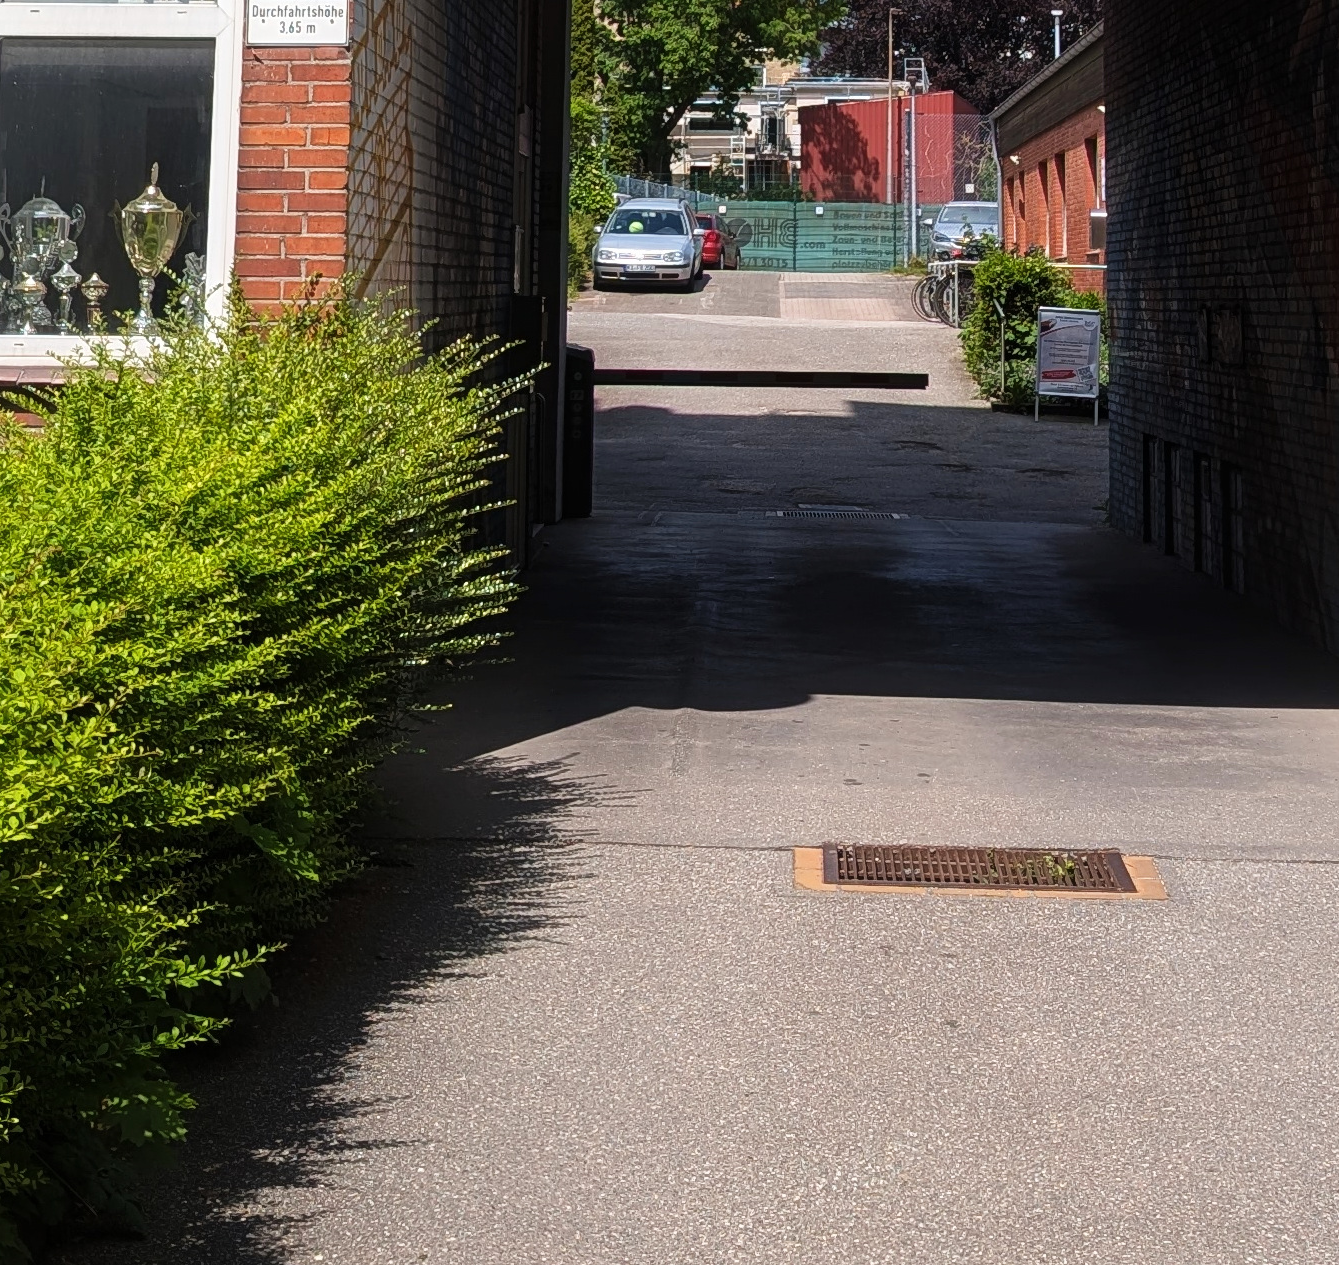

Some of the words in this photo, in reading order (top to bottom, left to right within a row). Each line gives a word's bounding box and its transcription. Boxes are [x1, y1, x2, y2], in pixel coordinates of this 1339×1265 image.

[252, 4, 344, 18] Durchfahrtshöhe
[279, 21, 302, 34] 3,65
[306, 24, 316, 33] m
